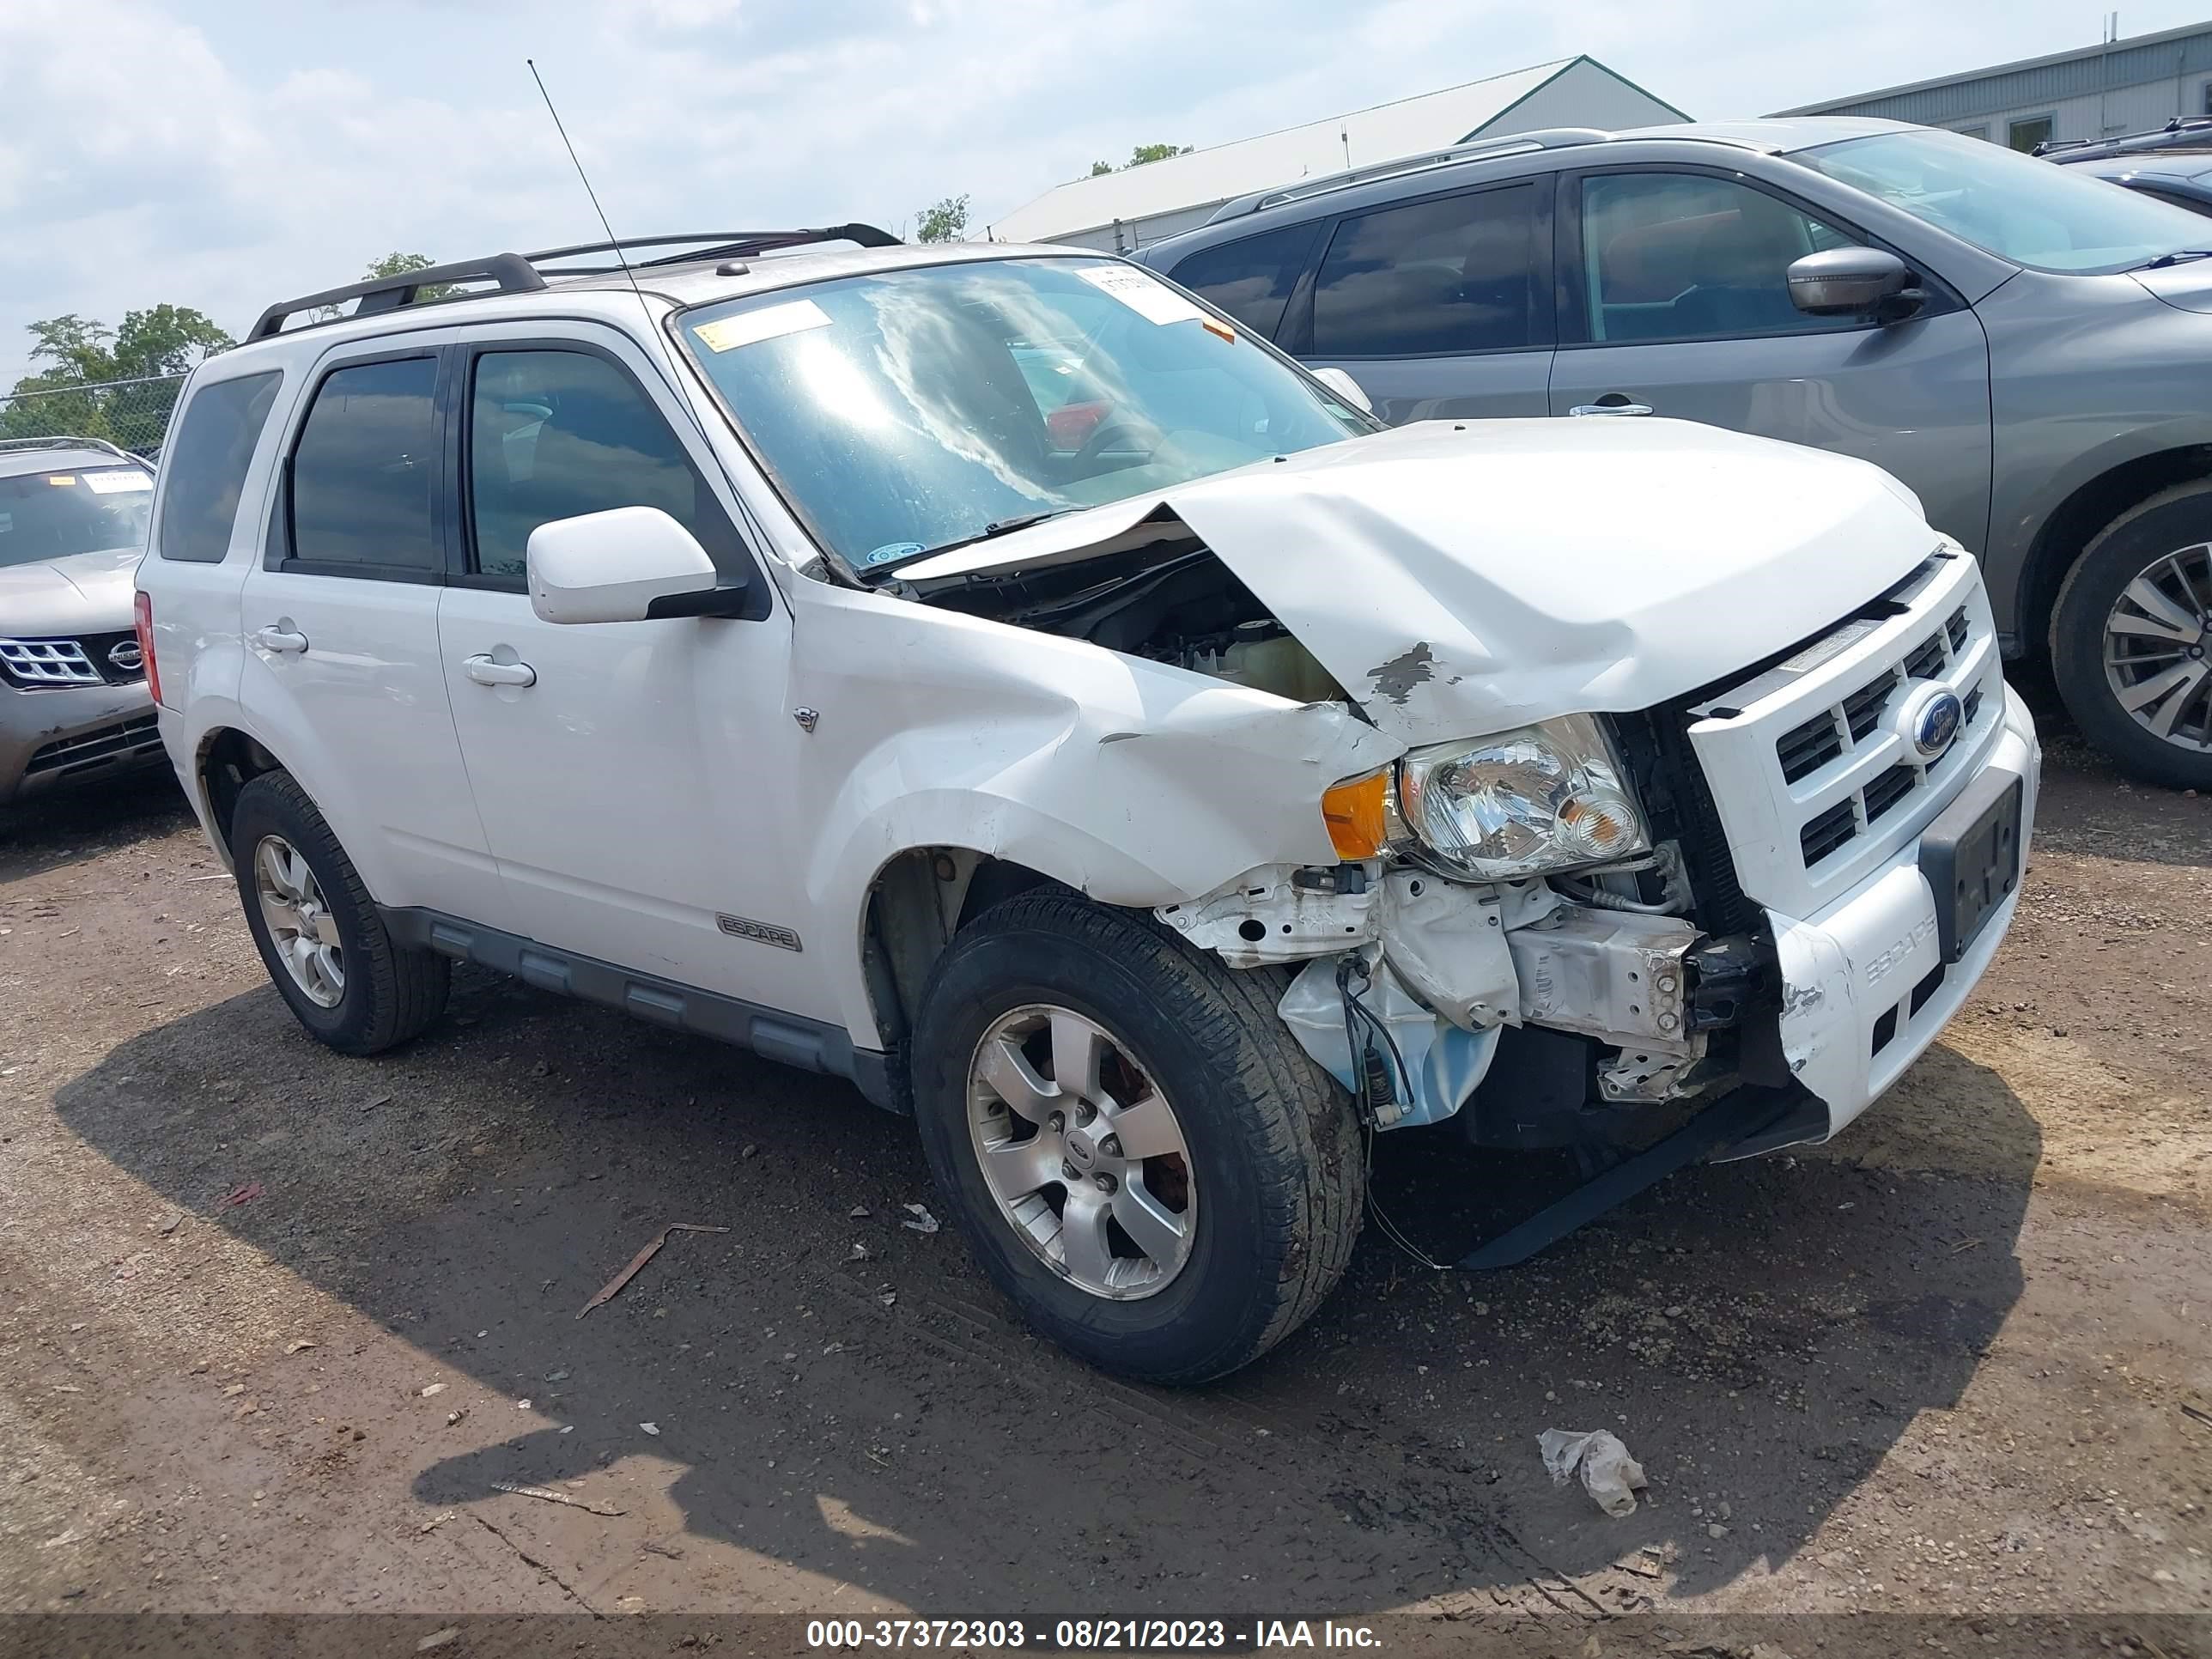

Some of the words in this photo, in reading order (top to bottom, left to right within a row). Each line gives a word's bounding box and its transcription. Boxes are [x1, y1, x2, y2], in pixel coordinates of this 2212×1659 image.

[113, 651, 142, 661] NISSA
[722, 918, 794, 947] ESCAPE
[1864, 913, 1938, 989] ESCAPE
